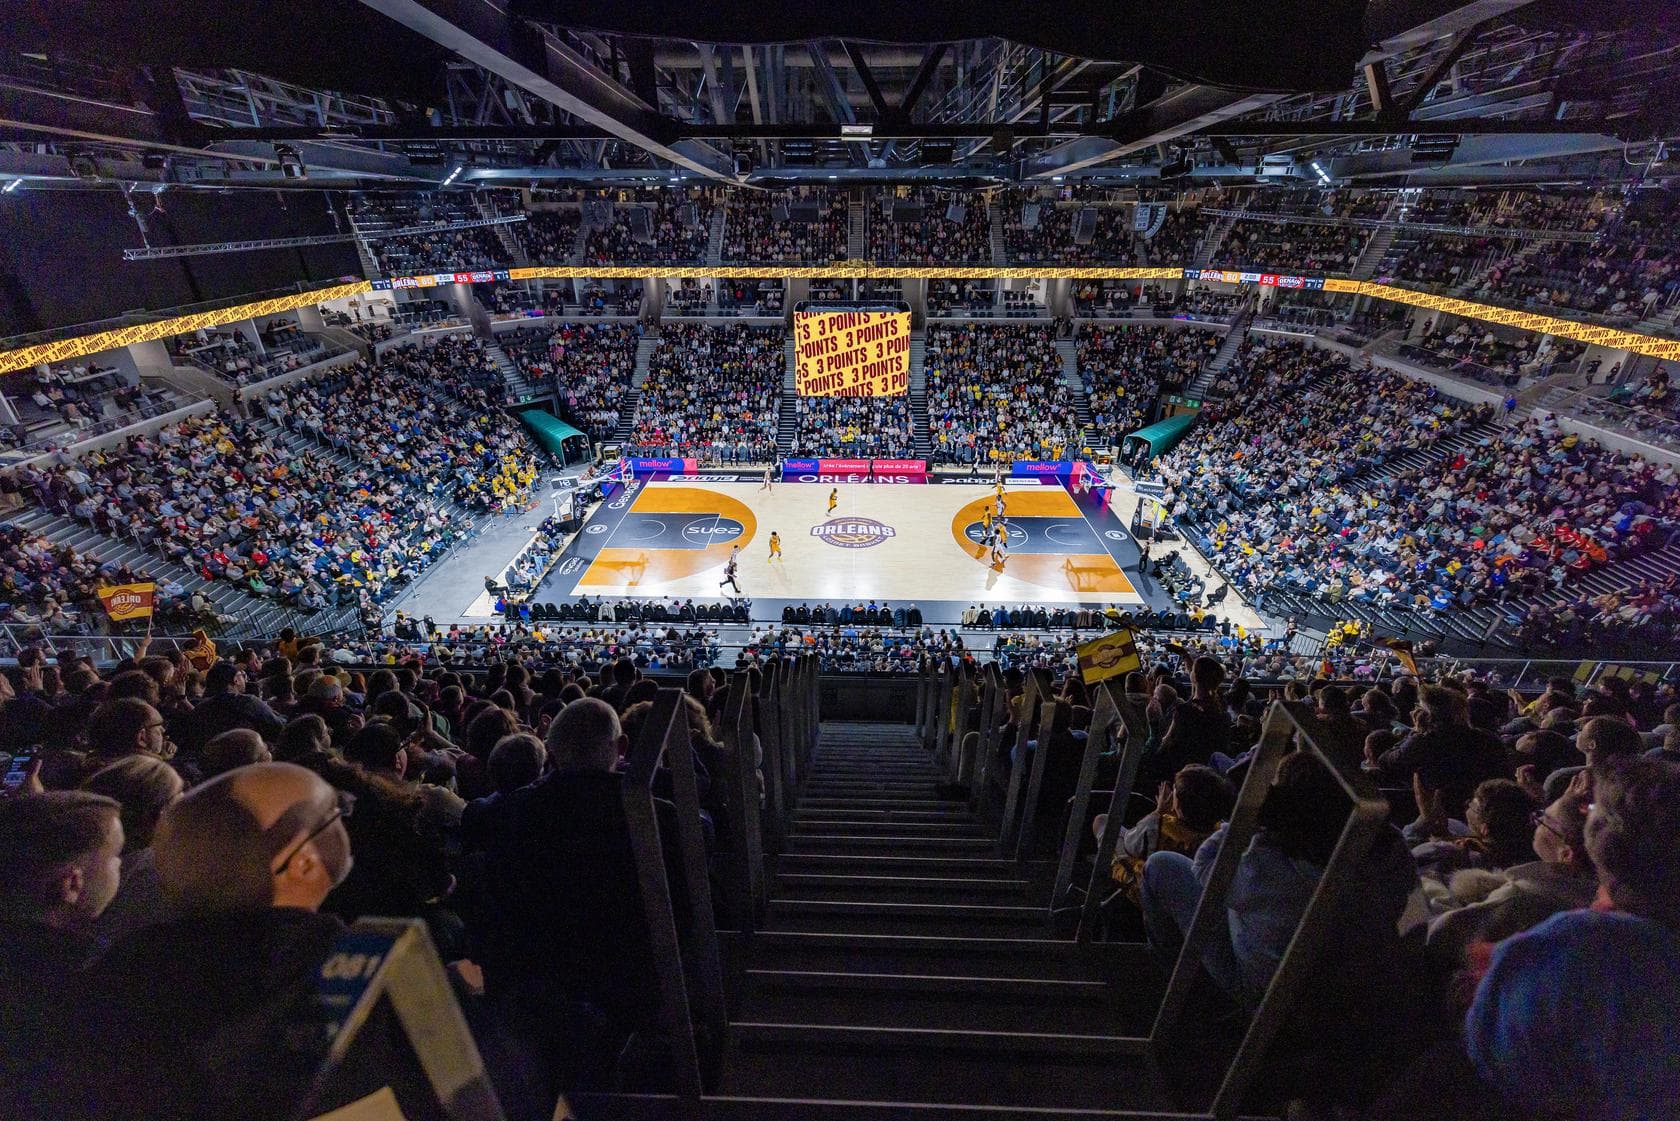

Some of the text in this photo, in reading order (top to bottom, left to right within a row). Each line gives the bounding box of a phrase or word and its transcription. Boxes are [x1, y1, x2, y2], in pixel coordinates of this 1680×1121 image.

[800, 323, 810, 339] S
[818, 320, 826, 336] 3
[829, 312, 870, 333] POINTS
[846, 332, 853, 347] 3
[857, 319, 898, 345] POINTS
[52, 351, 59, 359] 3
[57, 340, 78, 357] POINTS
[1646, 343, 1679, 353] 3 POINTS
[817, 358, 824, 374] 3
[827, 347, 867, 371] POINTS
[876, 342, 884, 358] 3
[804, 356, 902, 396] POINTS 3 POINTS
[882, 377, 888, 392] 3
[798, 473, 909, 483] ORLÉANS
[812, 524, 894, 536] ORLEANS
